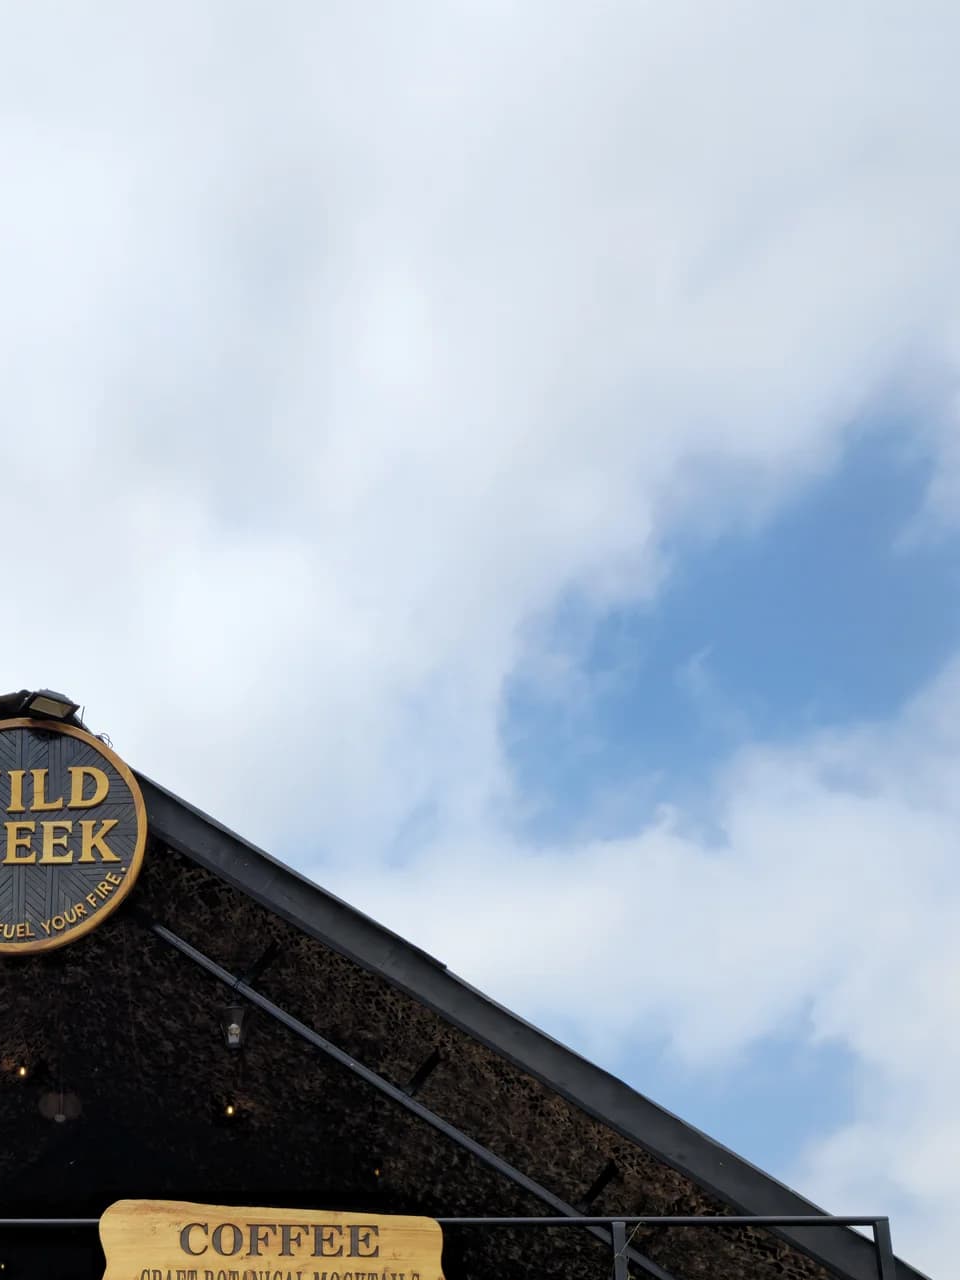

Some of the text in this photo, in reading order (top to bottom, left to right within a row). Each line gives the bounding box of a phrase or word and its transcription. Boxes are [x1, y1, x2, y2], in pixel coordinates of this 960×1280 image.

[41, 903, 88, 934] YOUR
[86, 871, 122, 907] FIRE
[179, 1222, 380, 1258] COFFEE
